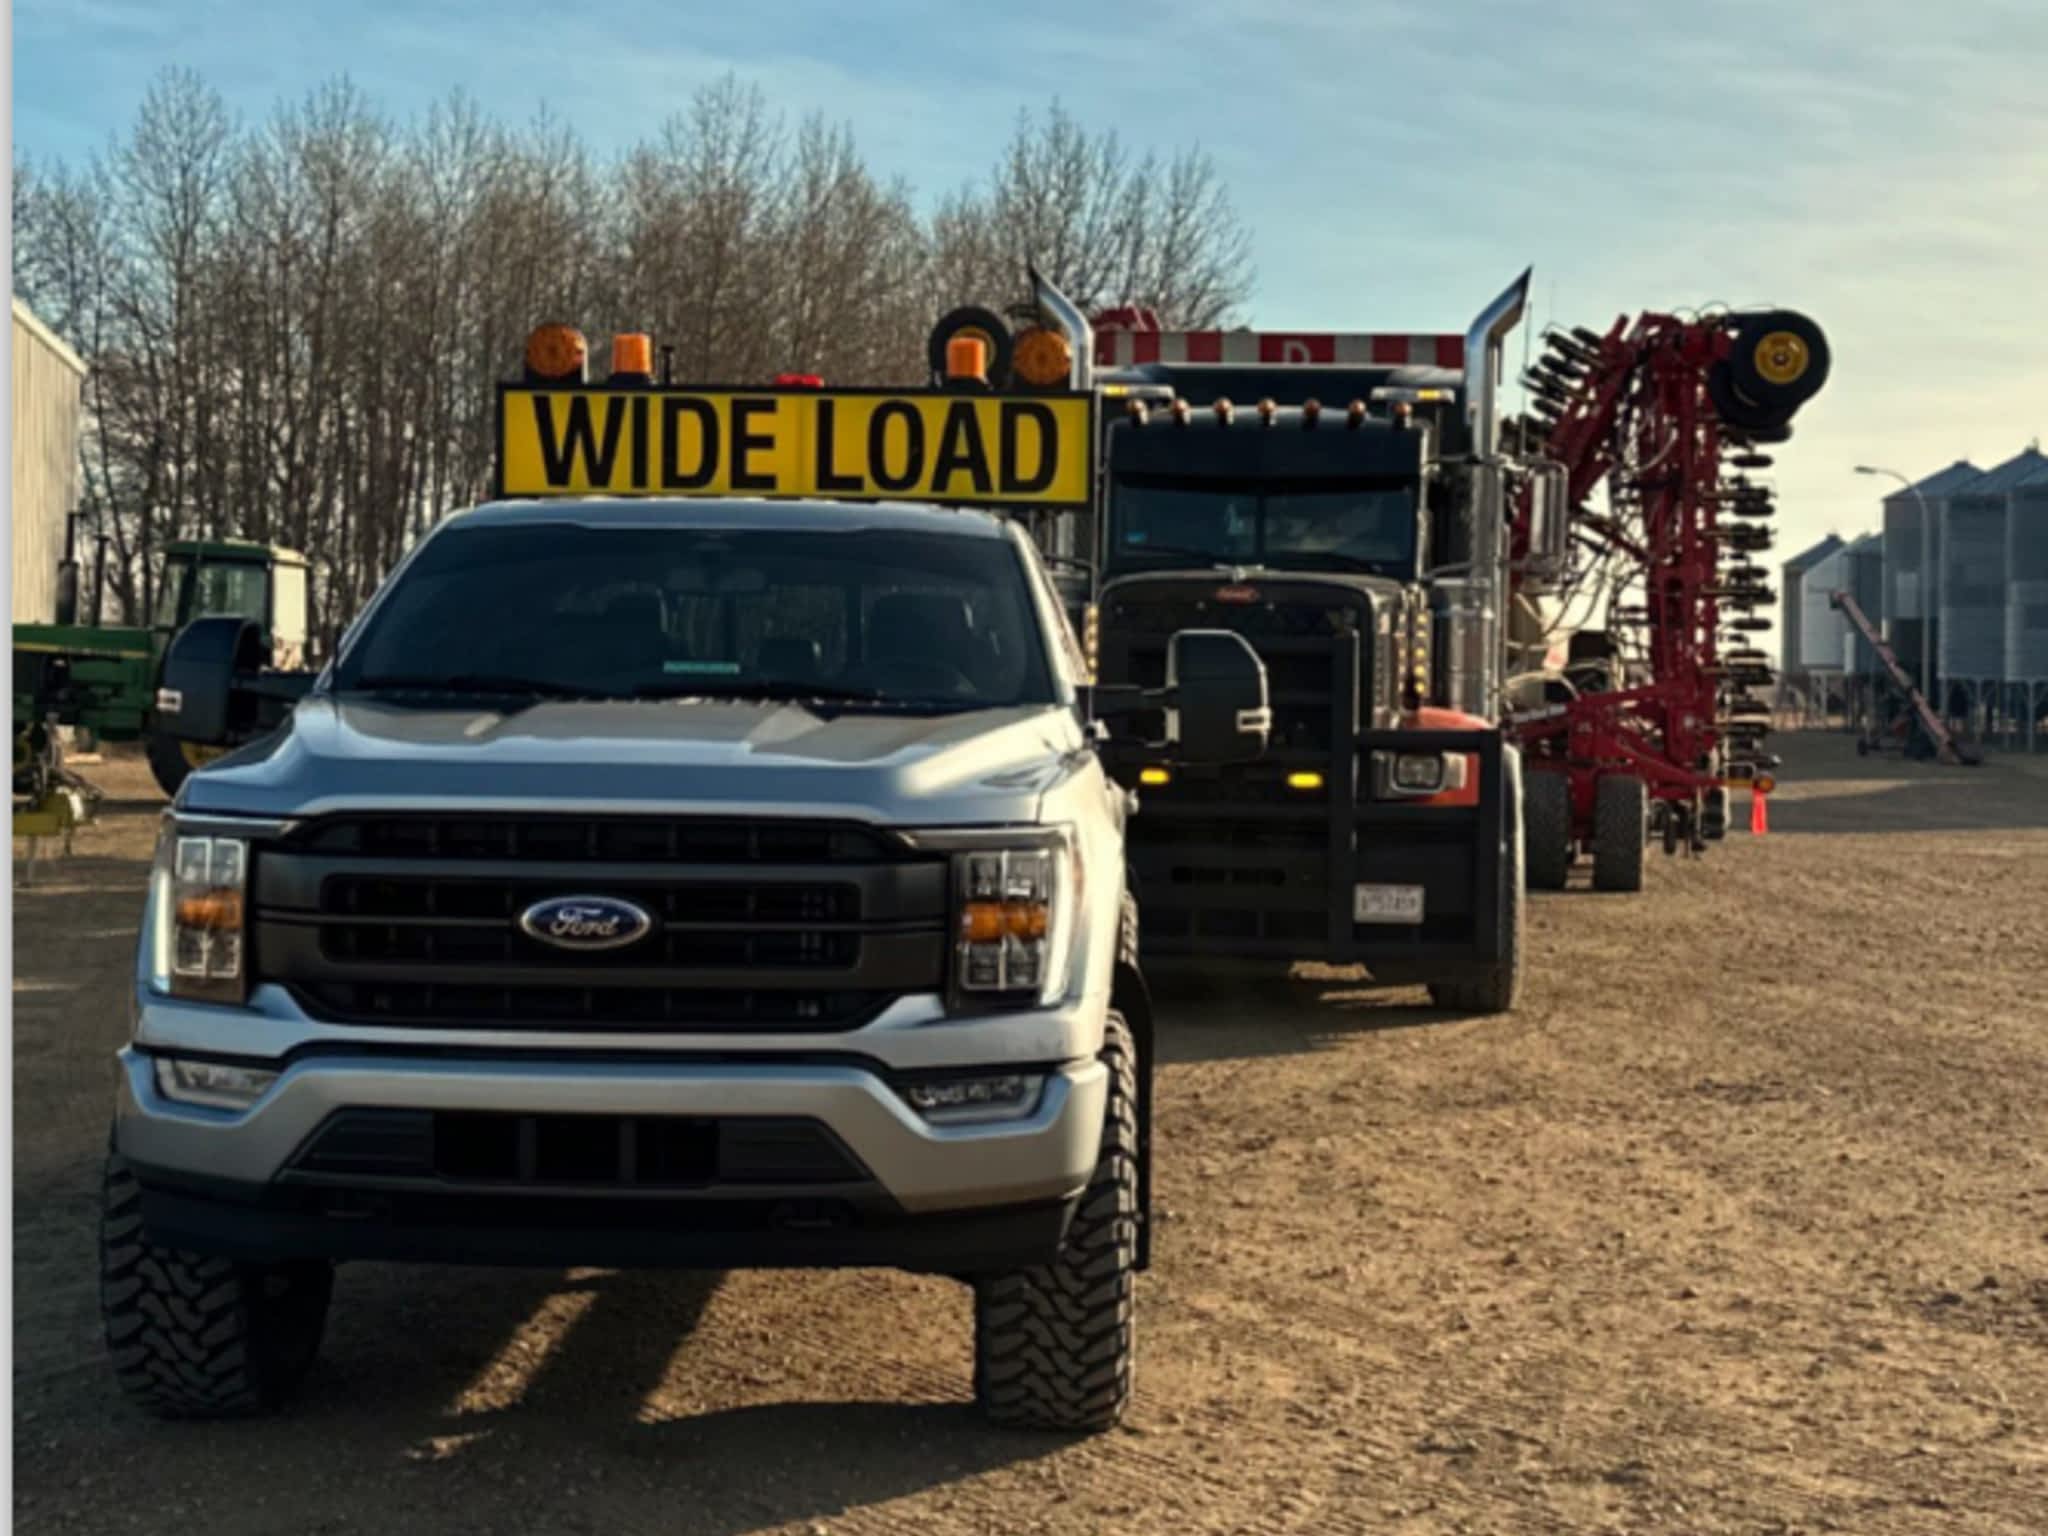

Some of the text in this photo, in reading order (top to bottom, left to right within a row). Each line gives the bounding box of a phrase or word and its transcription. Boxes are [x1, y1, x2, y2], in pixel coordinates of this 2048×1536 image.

[532, 394, 1059, 494] WIDE LOAD
[551, 905, 621, 936] Ford
